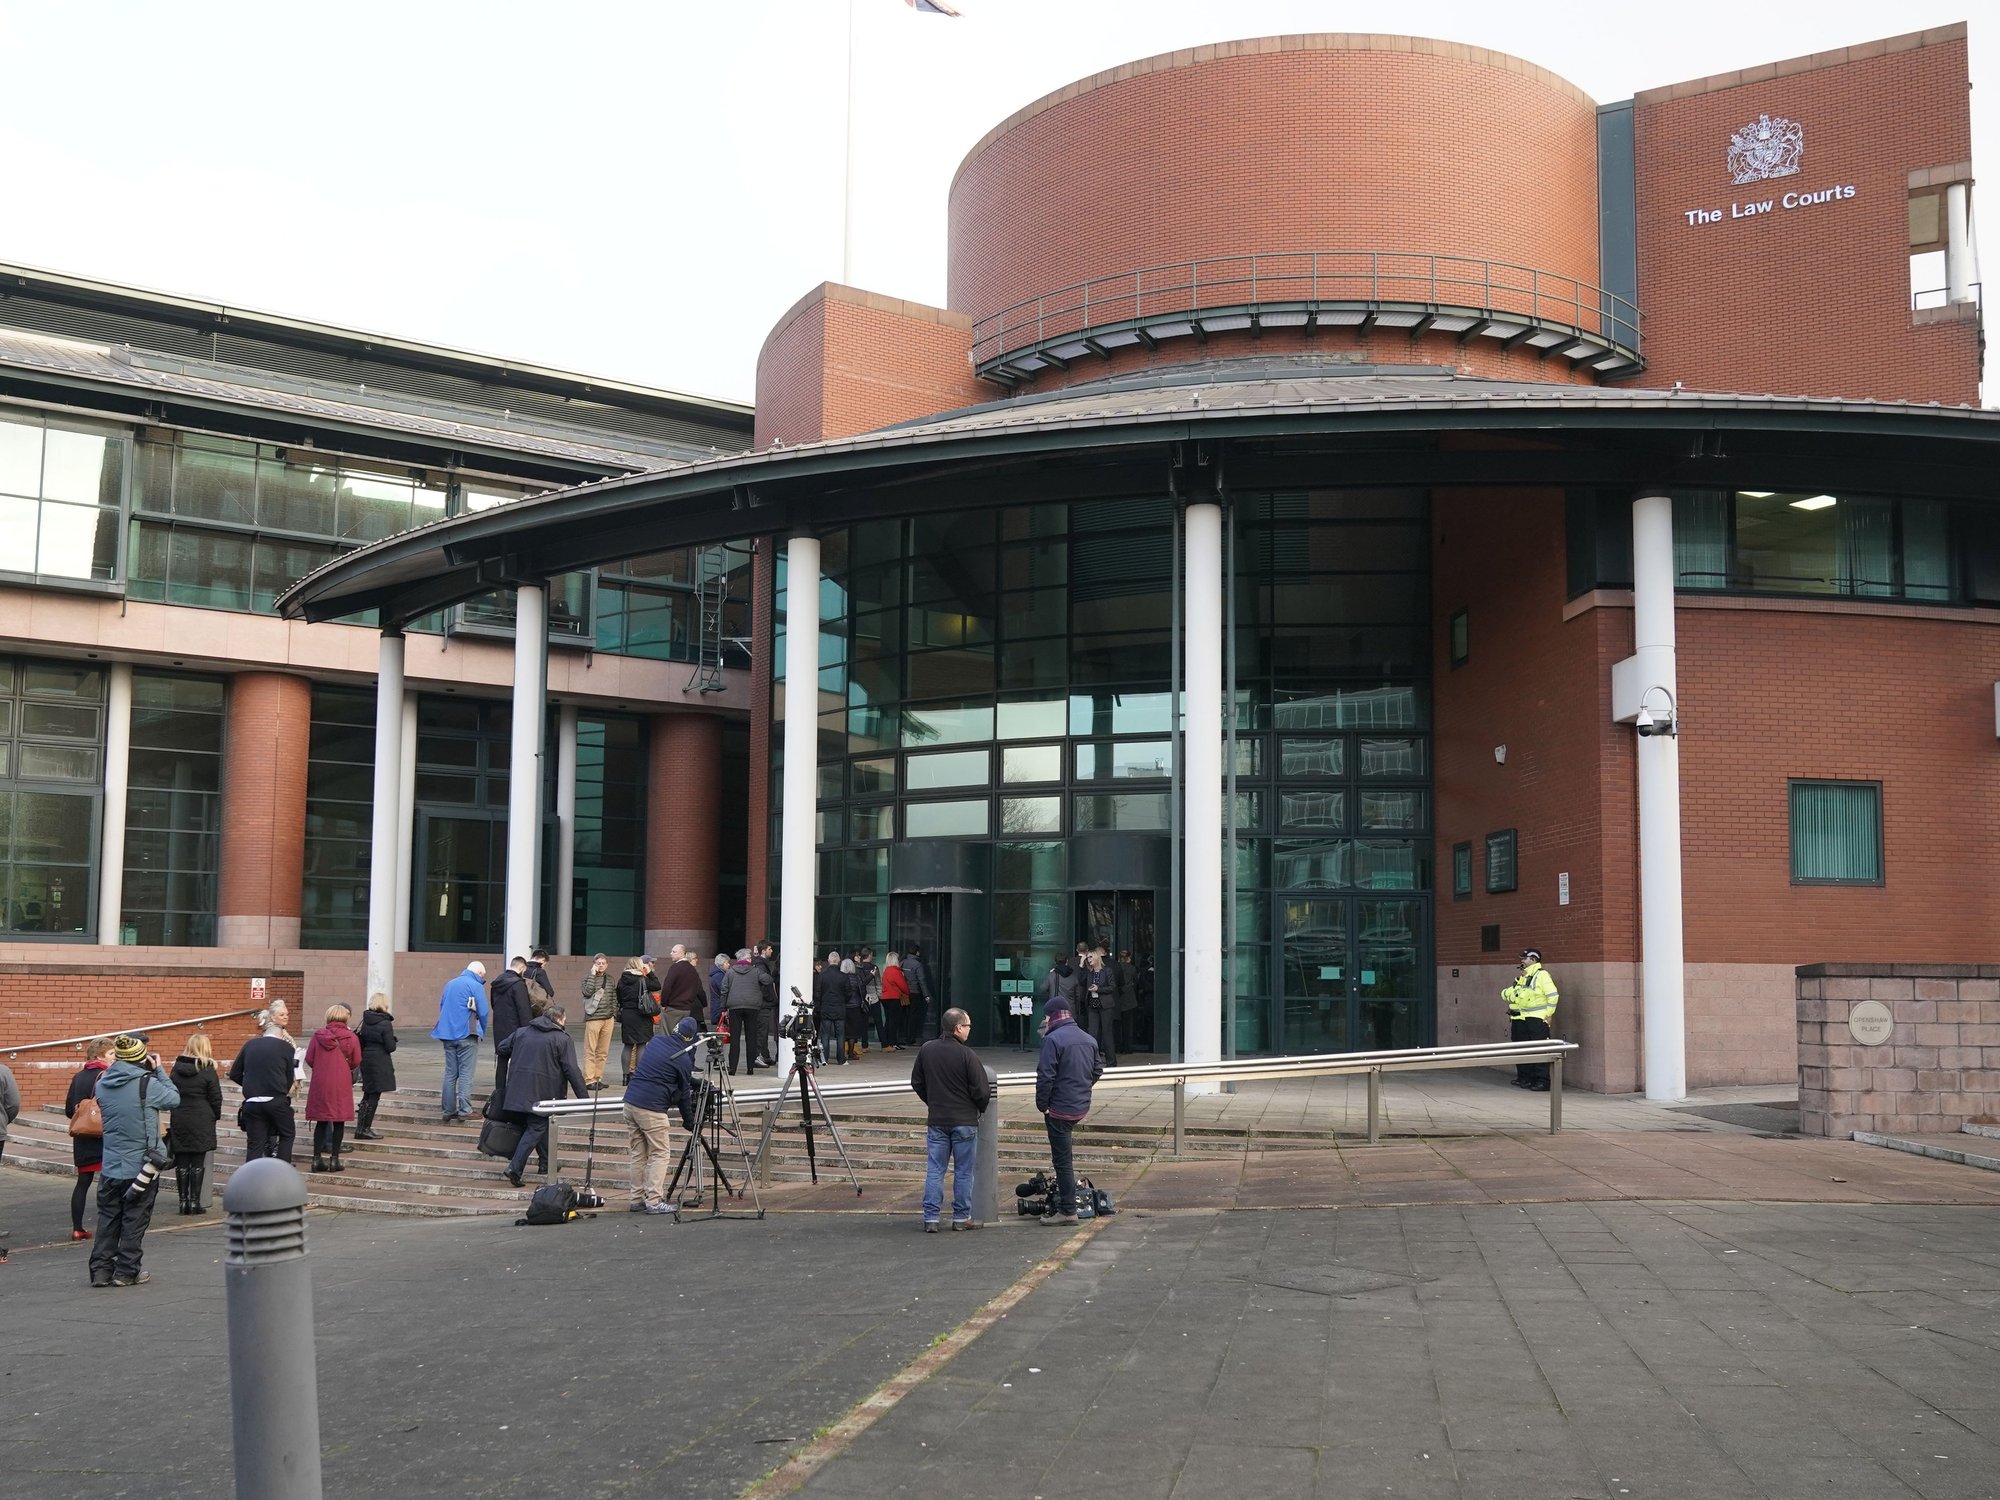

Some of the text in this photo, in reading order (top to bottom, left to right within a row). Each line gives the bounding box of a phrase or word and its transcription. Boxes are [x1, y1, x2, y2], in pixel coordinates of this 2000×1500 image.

[1685, 184, 1856, 226] The Law Courts
